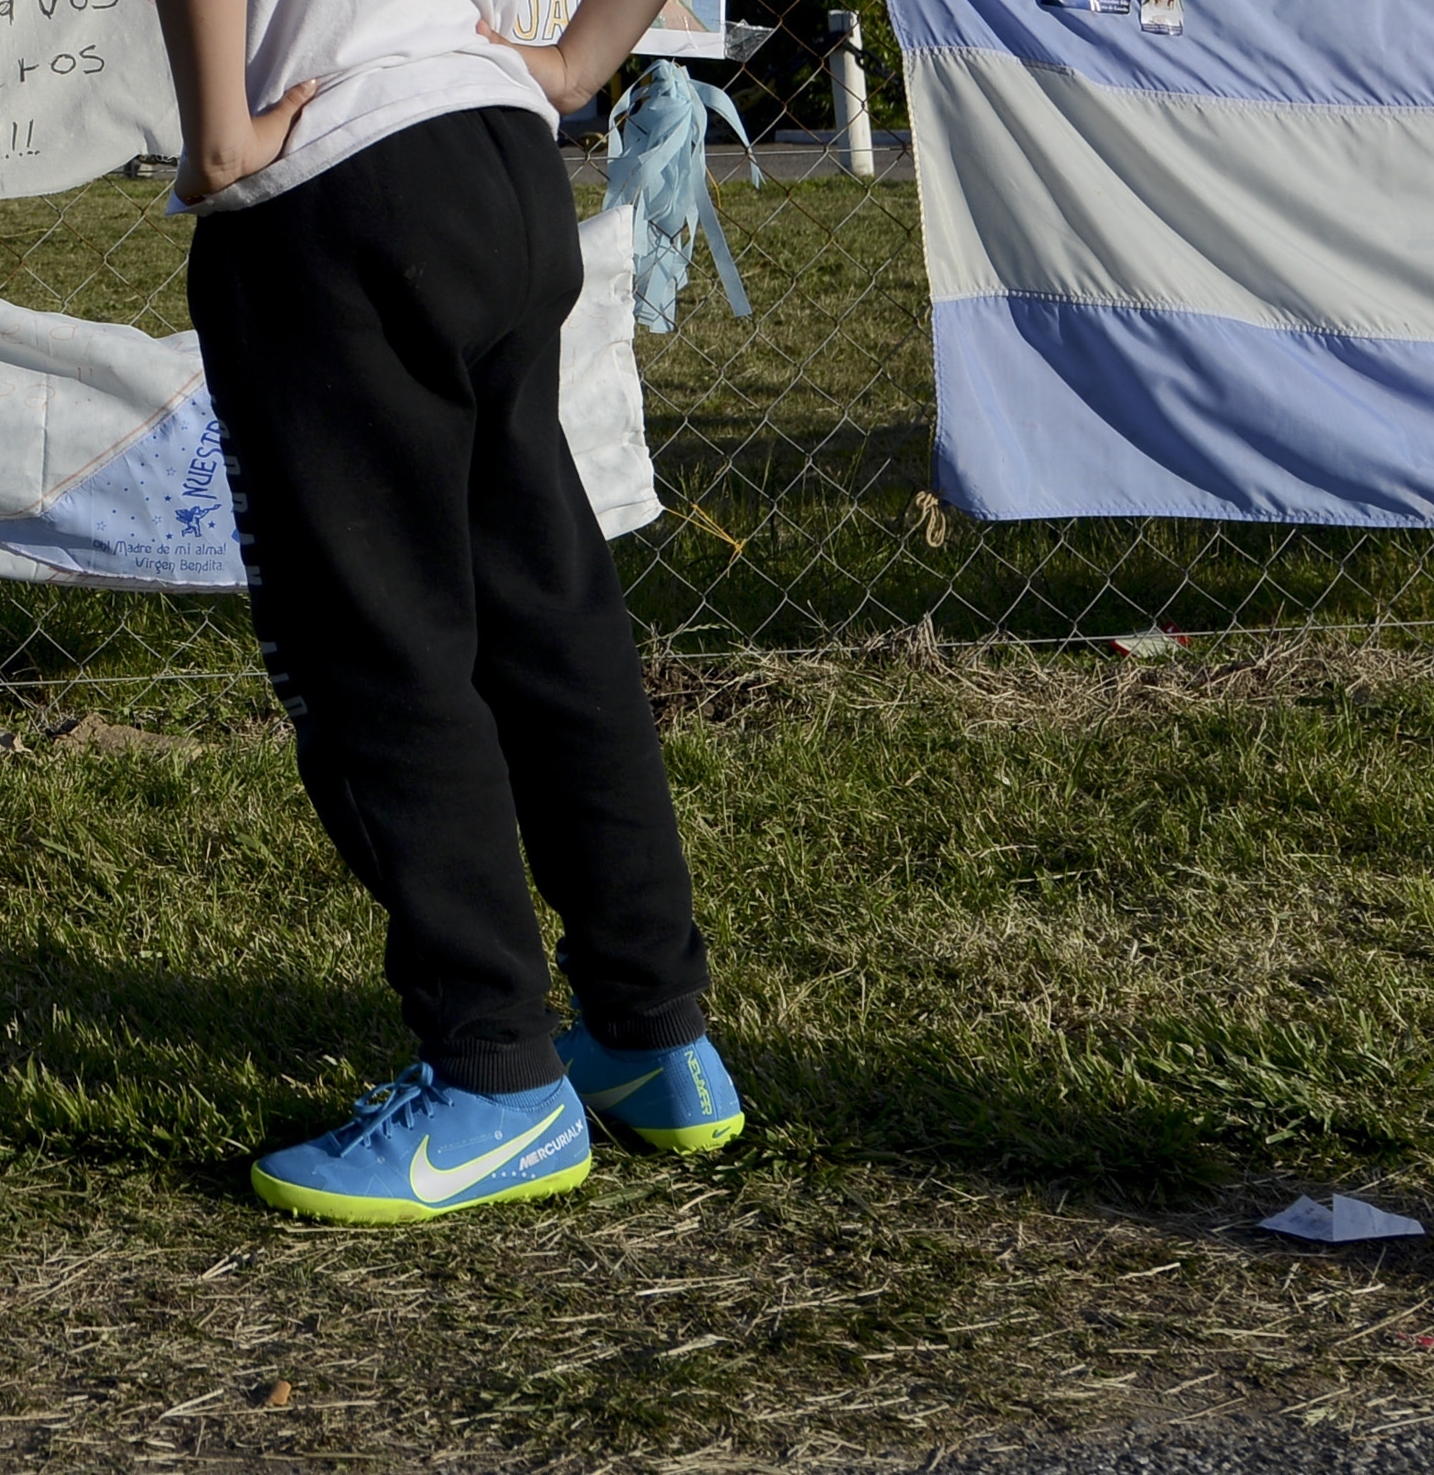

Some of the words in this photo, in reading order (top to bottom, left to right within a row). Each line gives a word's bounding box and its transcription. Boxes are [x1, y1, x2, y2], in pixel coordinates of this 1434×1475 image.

[113, 540, 153, 557] Madre
[156, 542, 171, 555] de
[175, 542, 192, 555] mi
[196, 542, 227, 556] alma!
[135, 557, 176, 575] Virgen
[519, 1118, 584, 1172] MERCURIALX
